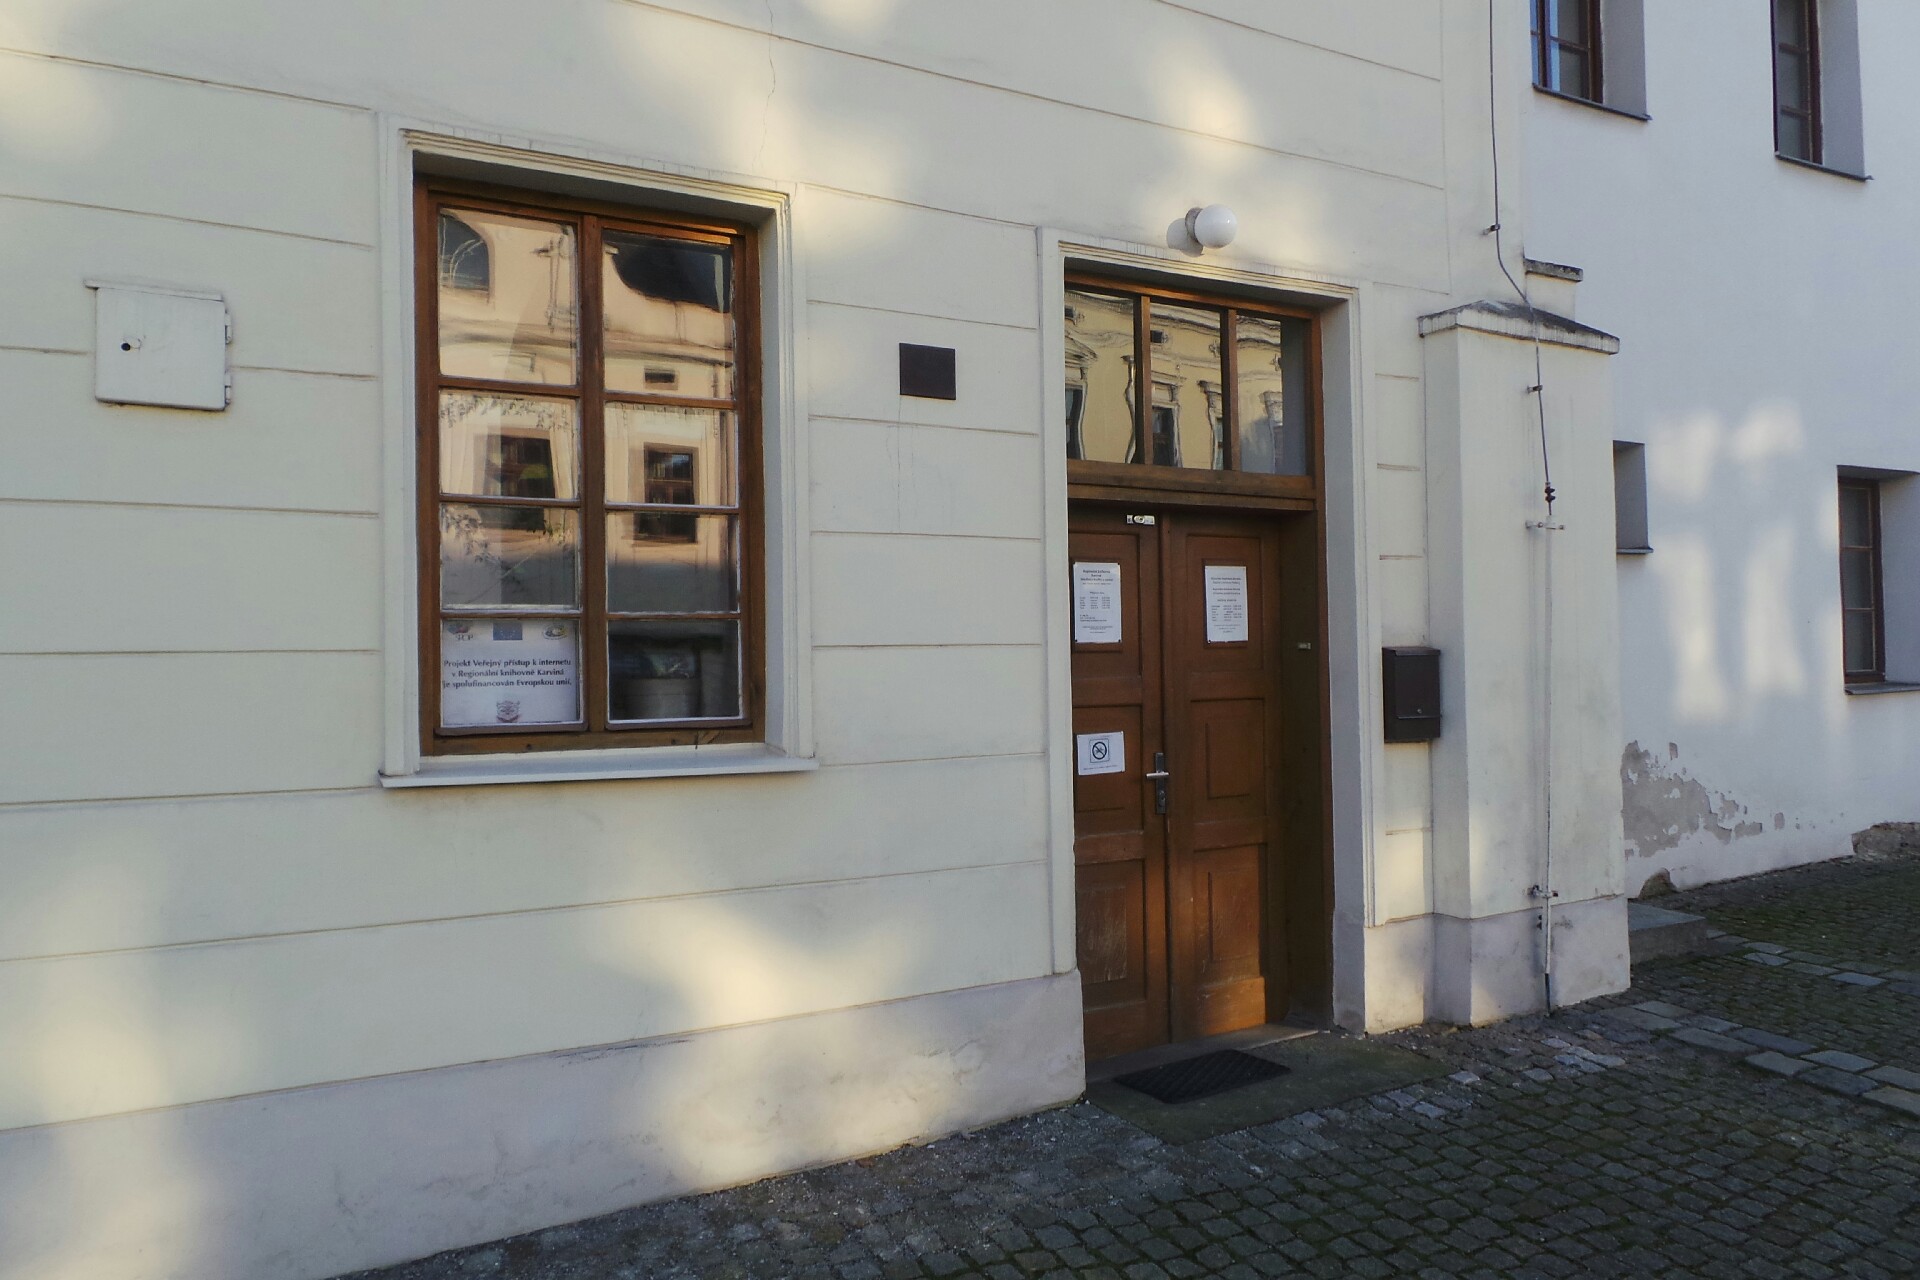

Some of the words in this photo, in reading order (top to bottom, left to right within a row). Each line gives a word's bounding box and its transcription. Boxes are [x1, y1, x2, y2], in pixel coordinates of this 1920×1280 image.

[444, 659, 470, 667] Projekt
[473, 658, 502, 668] Veřejný
[504, 658, 530, 667] přístup
[538, 658, 571, 666] internetu
[458, 669, 498, 678] Regionální
[443, 681, 450, 689] je
[453, 680, 514, 689] spolufinancován
[517, 679, 554, 688] Evropskou
